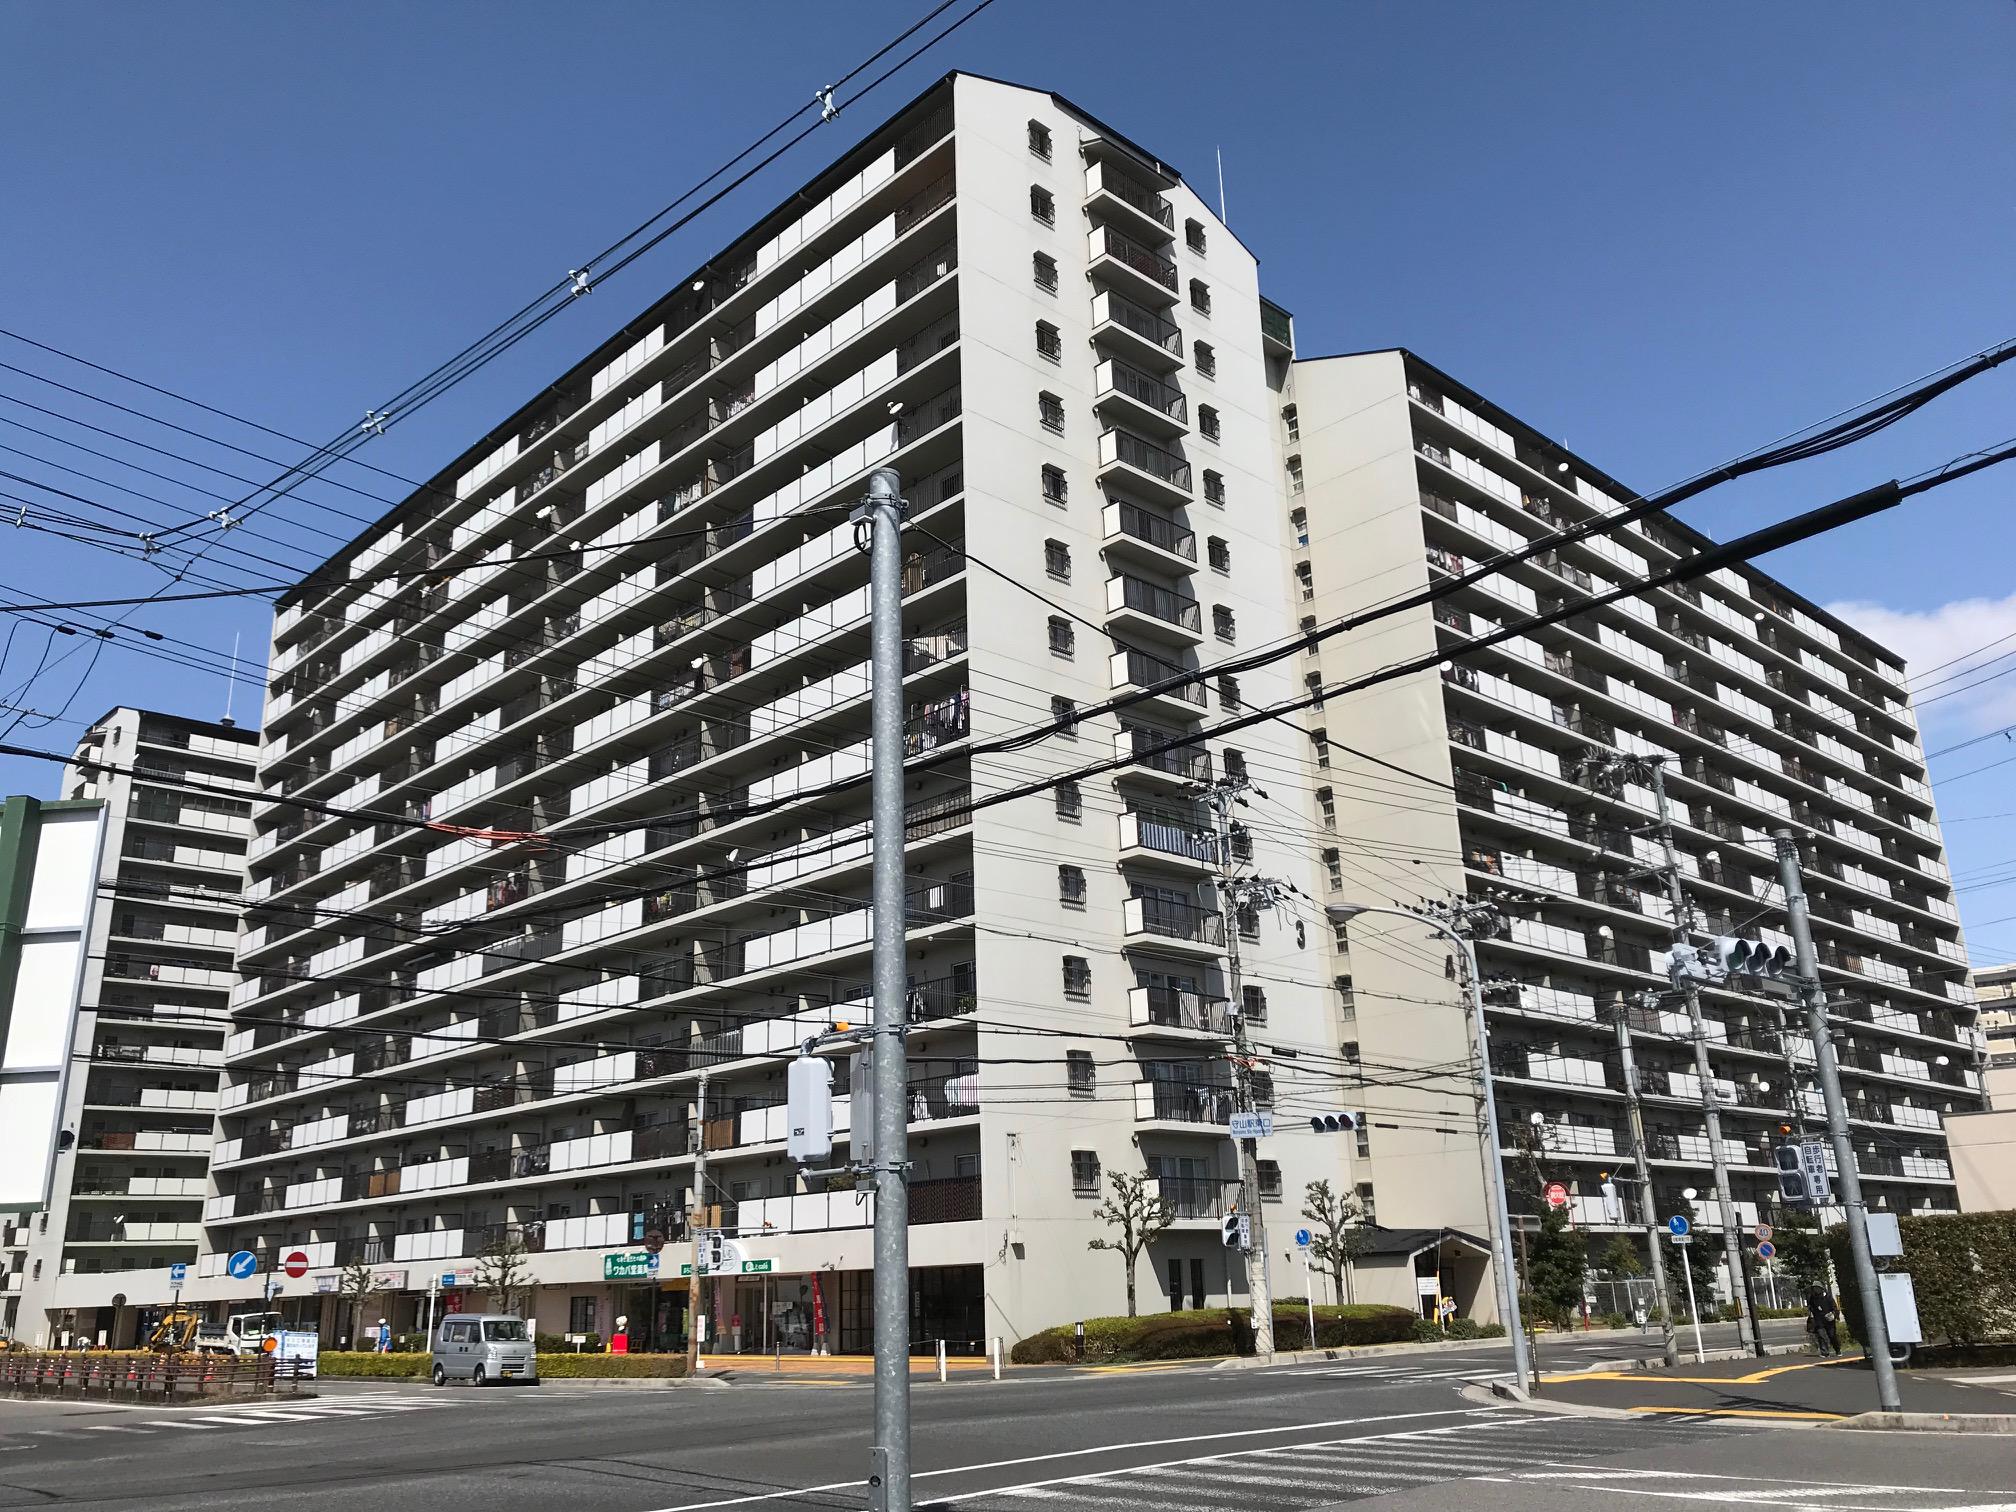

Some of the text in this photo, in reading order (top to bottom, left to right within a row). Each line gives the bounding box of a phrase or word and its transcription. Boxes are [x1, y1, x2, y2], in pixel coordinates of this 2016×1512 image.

[1232, 1119, 1270, 1128] 守山駅東口
[1804, 1146, 1815, 1173] 自転車
[1759, 1228, 1769, 1236] 40
